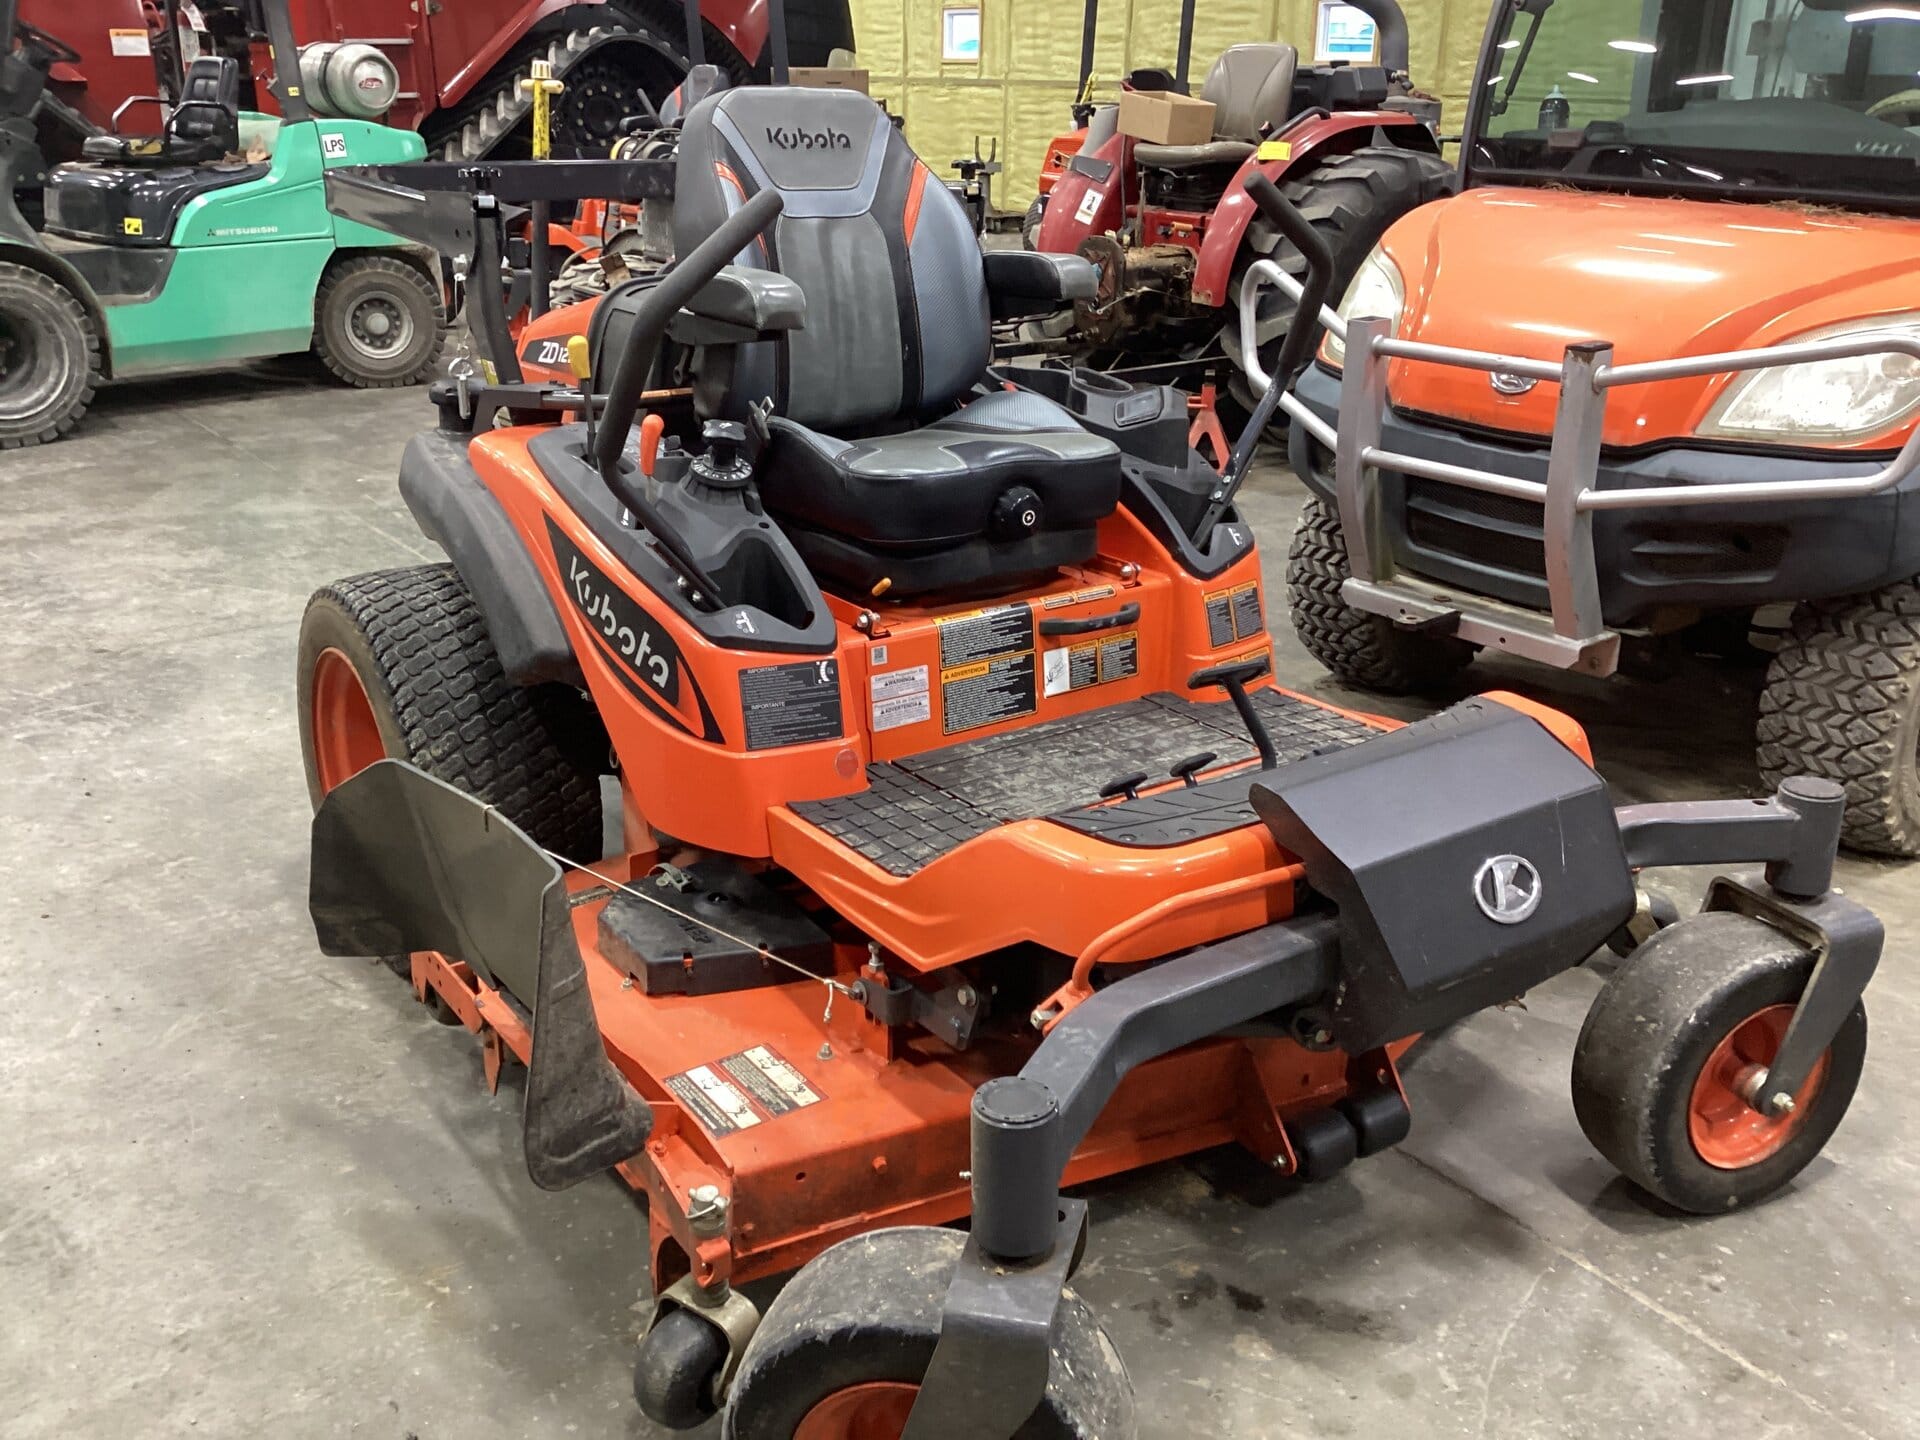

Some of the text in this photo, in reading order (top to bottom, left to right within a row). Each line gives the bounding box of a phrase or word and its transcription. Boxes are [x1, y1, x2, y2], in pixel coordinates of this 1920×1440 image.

[765, 127, 851, 150] Kubota
[324, 138, 346, 153] LPS
[215, 225, 279, 236] MITSUBISHI
[537, 340, 571, 364] ZD12
[569, 554, 670, 689] Kubota
[747, 665, 778, 674] IMPORTANT
[951, 666, 986, 678] ADVERTENCIA
[751, 701, 786, 711] IMPORTANTE
